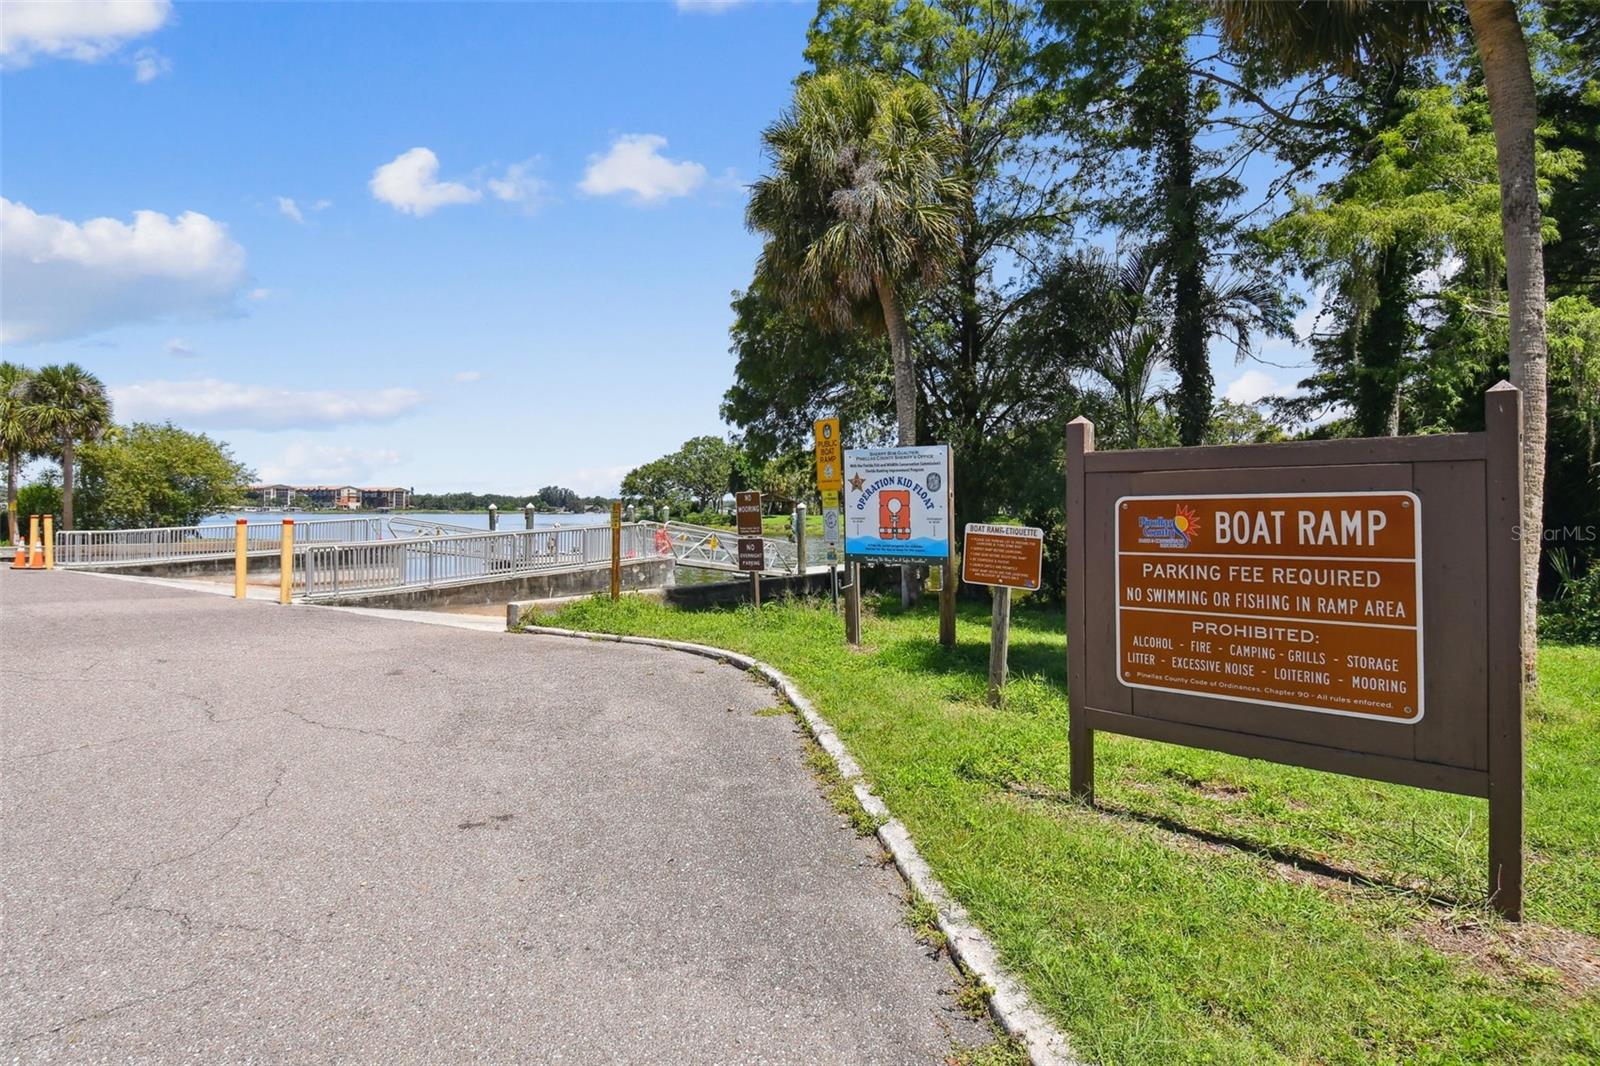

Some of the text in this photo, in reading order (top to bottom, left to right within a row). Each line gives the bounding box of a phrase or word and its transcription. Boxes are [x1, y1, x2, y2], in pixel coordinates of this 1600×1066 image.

[857, 476, 934, 510] OPERATION KID FLOAT
[1214, 509, 1387, 546] BOAT RAMP
[1143, 562, 1381, 588] PARKING FEE REQUIRED
[1127, 587, 1406, 618] NO SWIMMING OR FISHING IN RAMP AREA
[1192, 621, 1320, 644] PROHIBITED:
[1133, 636, 1173, 650] ALCOHOL
[1191, 640, 1211, 654] FIRE
[1230, 644, 1276, 660] CAMPING
[1288, 649, 1326, 665] GRILLS
[1347, 655, 1399, 672] STORAGE
[1128, 652, 1155, 665] LITTER
[1172, 656, 1221, 673] EXCESSIVE
[1224, 663, 1254, 676] NOISE
[1274, 668, 1330, 685] LOITERING
[1352, 676, 1407, 694] MOORING
[1136, 672, 1162, 680] Pinellas
[1164, 675, 1188, 684] County
[1264, 687, 1295, 697] Chapter
[1353, 699, 1394, 709] enforced.
